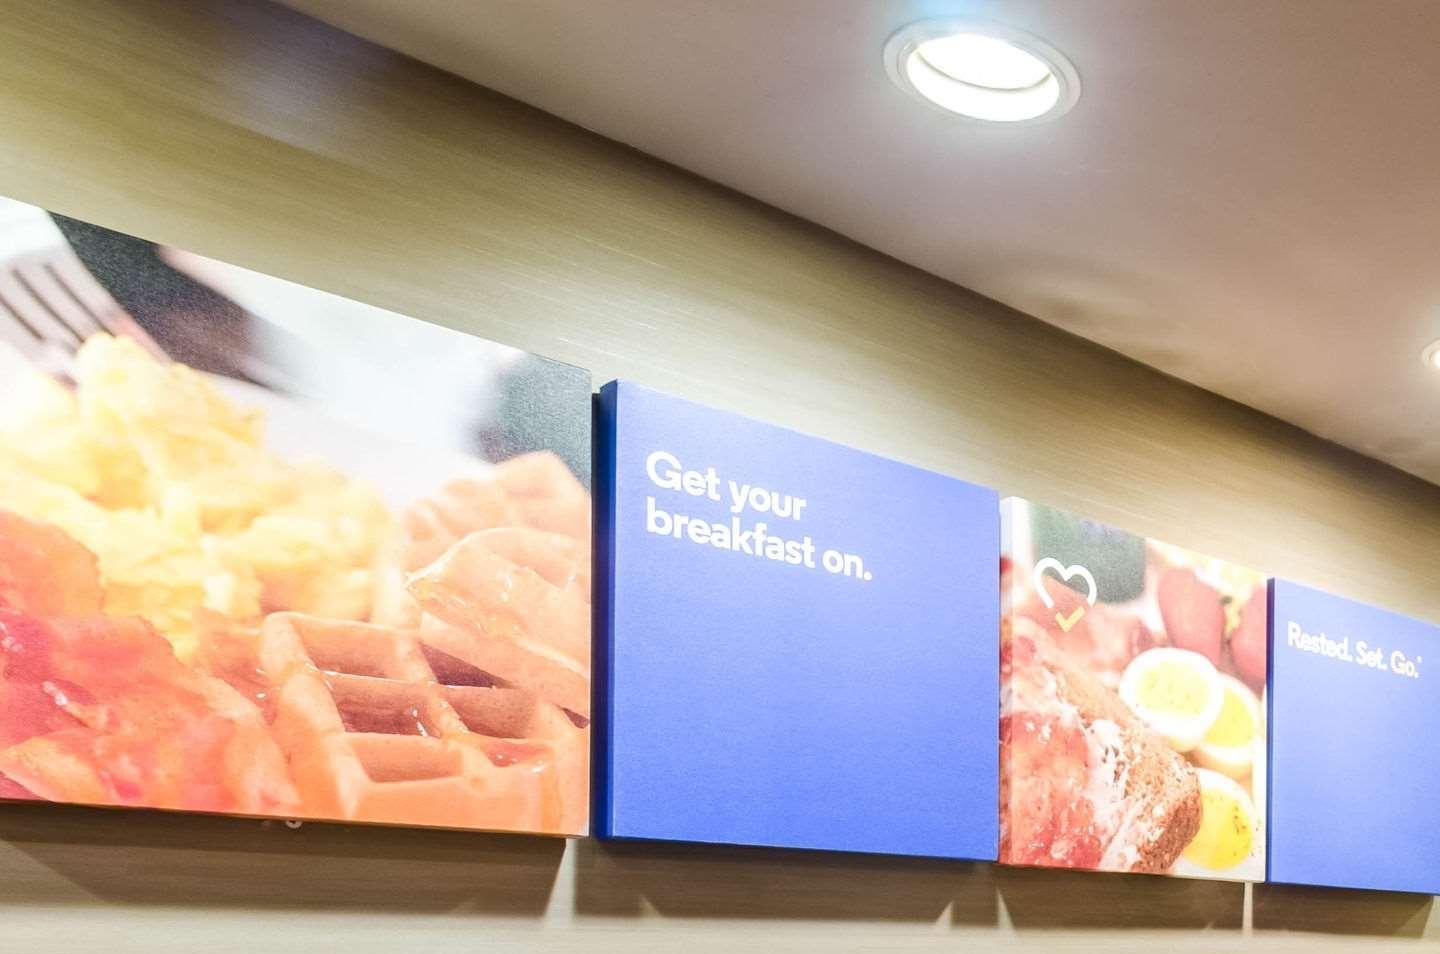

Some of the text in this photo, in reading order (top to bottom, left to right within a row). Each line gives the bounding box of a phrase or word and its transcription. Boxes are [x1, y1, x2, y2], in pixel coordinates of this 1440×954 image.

[646, 451, 807, 520] Get your
[646, 496, 873, 581] breakfast on.
[1287, 620, 1353, 662] Rested.
[1356, 640, 1388, 671] Set.
